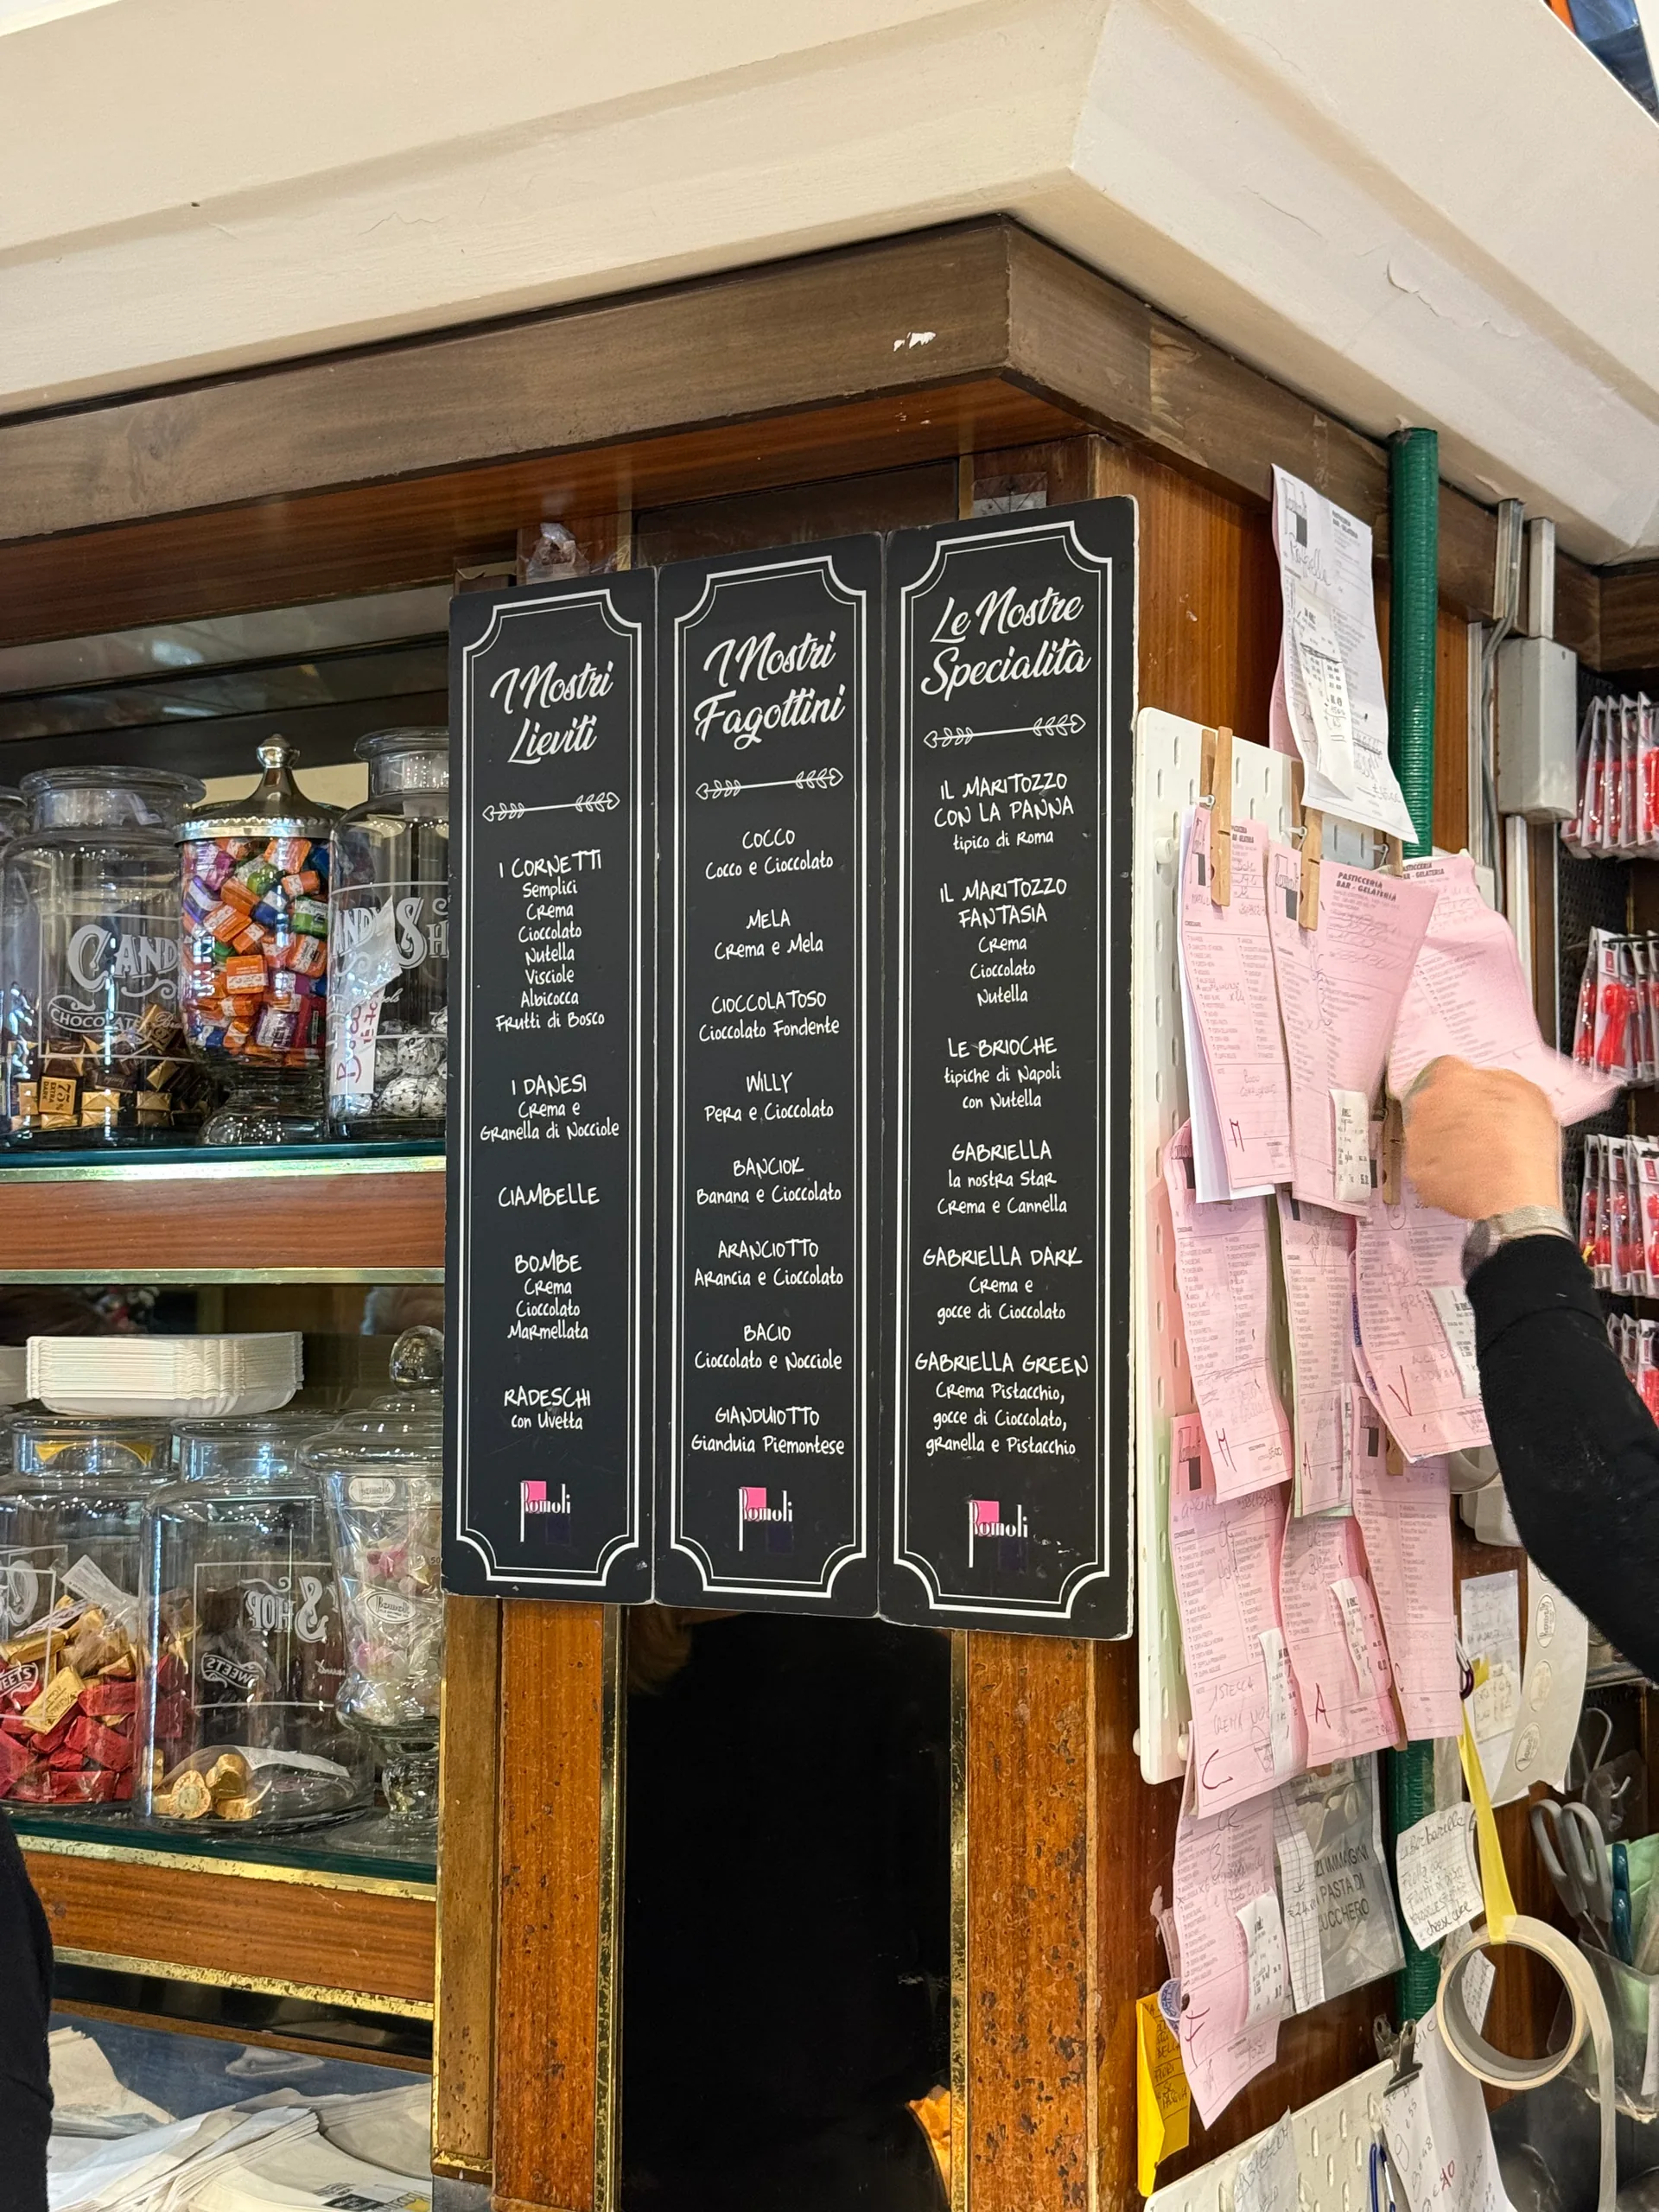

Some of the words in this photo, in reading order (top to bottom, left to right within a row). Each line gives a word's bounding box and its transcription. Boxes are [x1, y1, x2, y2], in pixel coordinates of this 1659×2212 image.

[930, 597, 971, 643] Le
[976, 587, 1084, 635] Nostre
[703, 639, 736, 687] I
[735, 631, 836, 682] Nostri
[921, 638, 1091, 702] Specialità
[490, 668, 520, 714] I
[519, 661, 613, 709] Nostri
[694, 684, 845, 750] Fagottini
[507, 715, 597, 764] Lieviti
[941, 780, 954, 800] IL
[963, 772, 1067, 798] MARITOZZO
[934, 806, 971, 827] CON
[979, 803, 1001, 822] LA
[1009, 795, 1074, 820] PANNA
[742, 829, 795, 849] COCCO
[953, 835, 989, 854] tipico
[996, 830, 1010, 847] di
[499, 862, 503, 878] I
[512, 849, 601, 878] CORNETTI
[706, 862, 742, 880] Cocco
[749, 861, 757, 875] e
[765, 849, 833, 874] Cioccolato
[1402, 861, 1433, 872] ASTICCERIA
[523, 876, 577, 900] Semplici
[940, 883, 954, 903] IL
[962, 878, 1066, 901] MARITOZZO
[1336, 880, 1351, 890] BAR
[1357, 886, 1397, 902] GELATERIA
[1337, 871, 1383, 889] PASTICCERIA
[747, 909, 791, 929] MELA
[958, 903, 1047, 929] FANTASIA
[395, 897, 448, 969] SH
[518, 920, 582, 943] Cioccolato
[772, 942, 779, 955] e
[787, 931, 823, 953] Mela
[67, 924, 180, 993] CAND
[525, 942, 575, 965] Nutella
[525, 963, 574, 985] Visciole
[970, 958, 1035, 979] Cioccolato
[521, 988, 579, 1007] Albicocca
[712, 990, 826, 1014] CIOCCOLATOSO
[977, 983, 1027, 1006] Nutella
[548, 1011, 561, 1027] di
[568, 1012, 604, 1027] Bosco
[699, 1019, 766, 1041] Cioccolato
[773, 1015, 839, 1037] Fondente
[948, 1038, 969, 1058] LE
[978, 1036, 1057, 1058] BRIOCHE
[512, 1080, 516, 1095] I
[524, 1074, 586, 1096] DANESI
[747, 1071, 792, 1093] WILLY
[944, 1067, 989, 1088] tipiche
[996, 1065, 1010, 1082] di
[1018, 1061, 1061, 1084] Napoli
[41, 1081, 50, 1100] DARK
[48, 1082, 57, 1103] EXTRA
[57, 1084, 71, 1103] 75
[963, 1096, 982, 1109] con
[990, 1088, 1041, 1110] Nutella
[572, 1103, 580, 1116] e
[749, 1107, 757, 1121] e
[765, 1097, 833, 1120] Cioccolato
[546, 1122, 560, 1138] di
[567, 1116, 619, 1140] Nocciole
[952, 1140, 1052, 1162] GABRIELLA
[734, 1157, 804, 1179] BANCIOK
[949, 1169, 961, 1187] la
[499, 1183, 600, 1207] CIAMBELLE
[697, 1189, 749, 1205] Banana
[756, 1189, 764, 1203] e
[772, 1181, 841, 1203] Cioccolato
[993, 1201, 1000, 1213] e
[1007, 1193, 1067, 1213] Cannella
[718, 1238, 818, 1260] ARANCIOTTO
[923, 1245, 1021, 1267] GABRIELLA
[1031, 1246, 1083, 1267] DARK
[515, 1249, 582, 1274] BOMBE
[758, 1272, 766, 1286] e
[773, 1264, 843, 1286] Cioccolato
[1025, 1280, 1033, 1293] e
[516, 1297, 580, 1317] Cioccolato
[938, 1306, 970, 1325] gocce
[978, 1302, 992, 1319] di
[999, 1300, 1065, 1319] Cioccolato
[744, 1323, 791, 1341] BACIO
[695, 1348, 762, 1369] Cioccolato
[769, 1355, 777, 1369] e
[785, 1349, 842, 1371] Nocciole
[915, 1351, 1014, 1372] GABRIELLA
[1022, 1355, 1088, 1376] GREEN
[505, 1386, 590, 1411] RADESCHI
[991, 1382, 1065, 1404] Pistacchio,
[512, 1414, 531, 1428] con
[538, 1411, 582, 1429] Uvetta
[715, 1406, 819, 1427] GIANDUIOTTO
[933, 1411, 967, 1430] gocce
[974, 1408, 988, 1425] di
[995, 1408, 1066, 1431] Cioccolato,
[691, 1433, 755, 1452] Gianduia
[762, 1435, 844, 1454] Piemontese
[991, 1440, 999, 1452] e
[1007, 1436, 1076, 1455] Pistacchio
[519, 1480, 571, 1542] Romoli
[738, 1487, 792, 1552] Romoli
[969, 1500, 1028, 1567] Romoli
[0, 1667, 32, 1691] EETS
[1326, 1845, 1370, 1873] IMMAGINI
[1321, 1881, 1354, 1902] PASTA
[1354, 1872, 1365, 1891] DI
